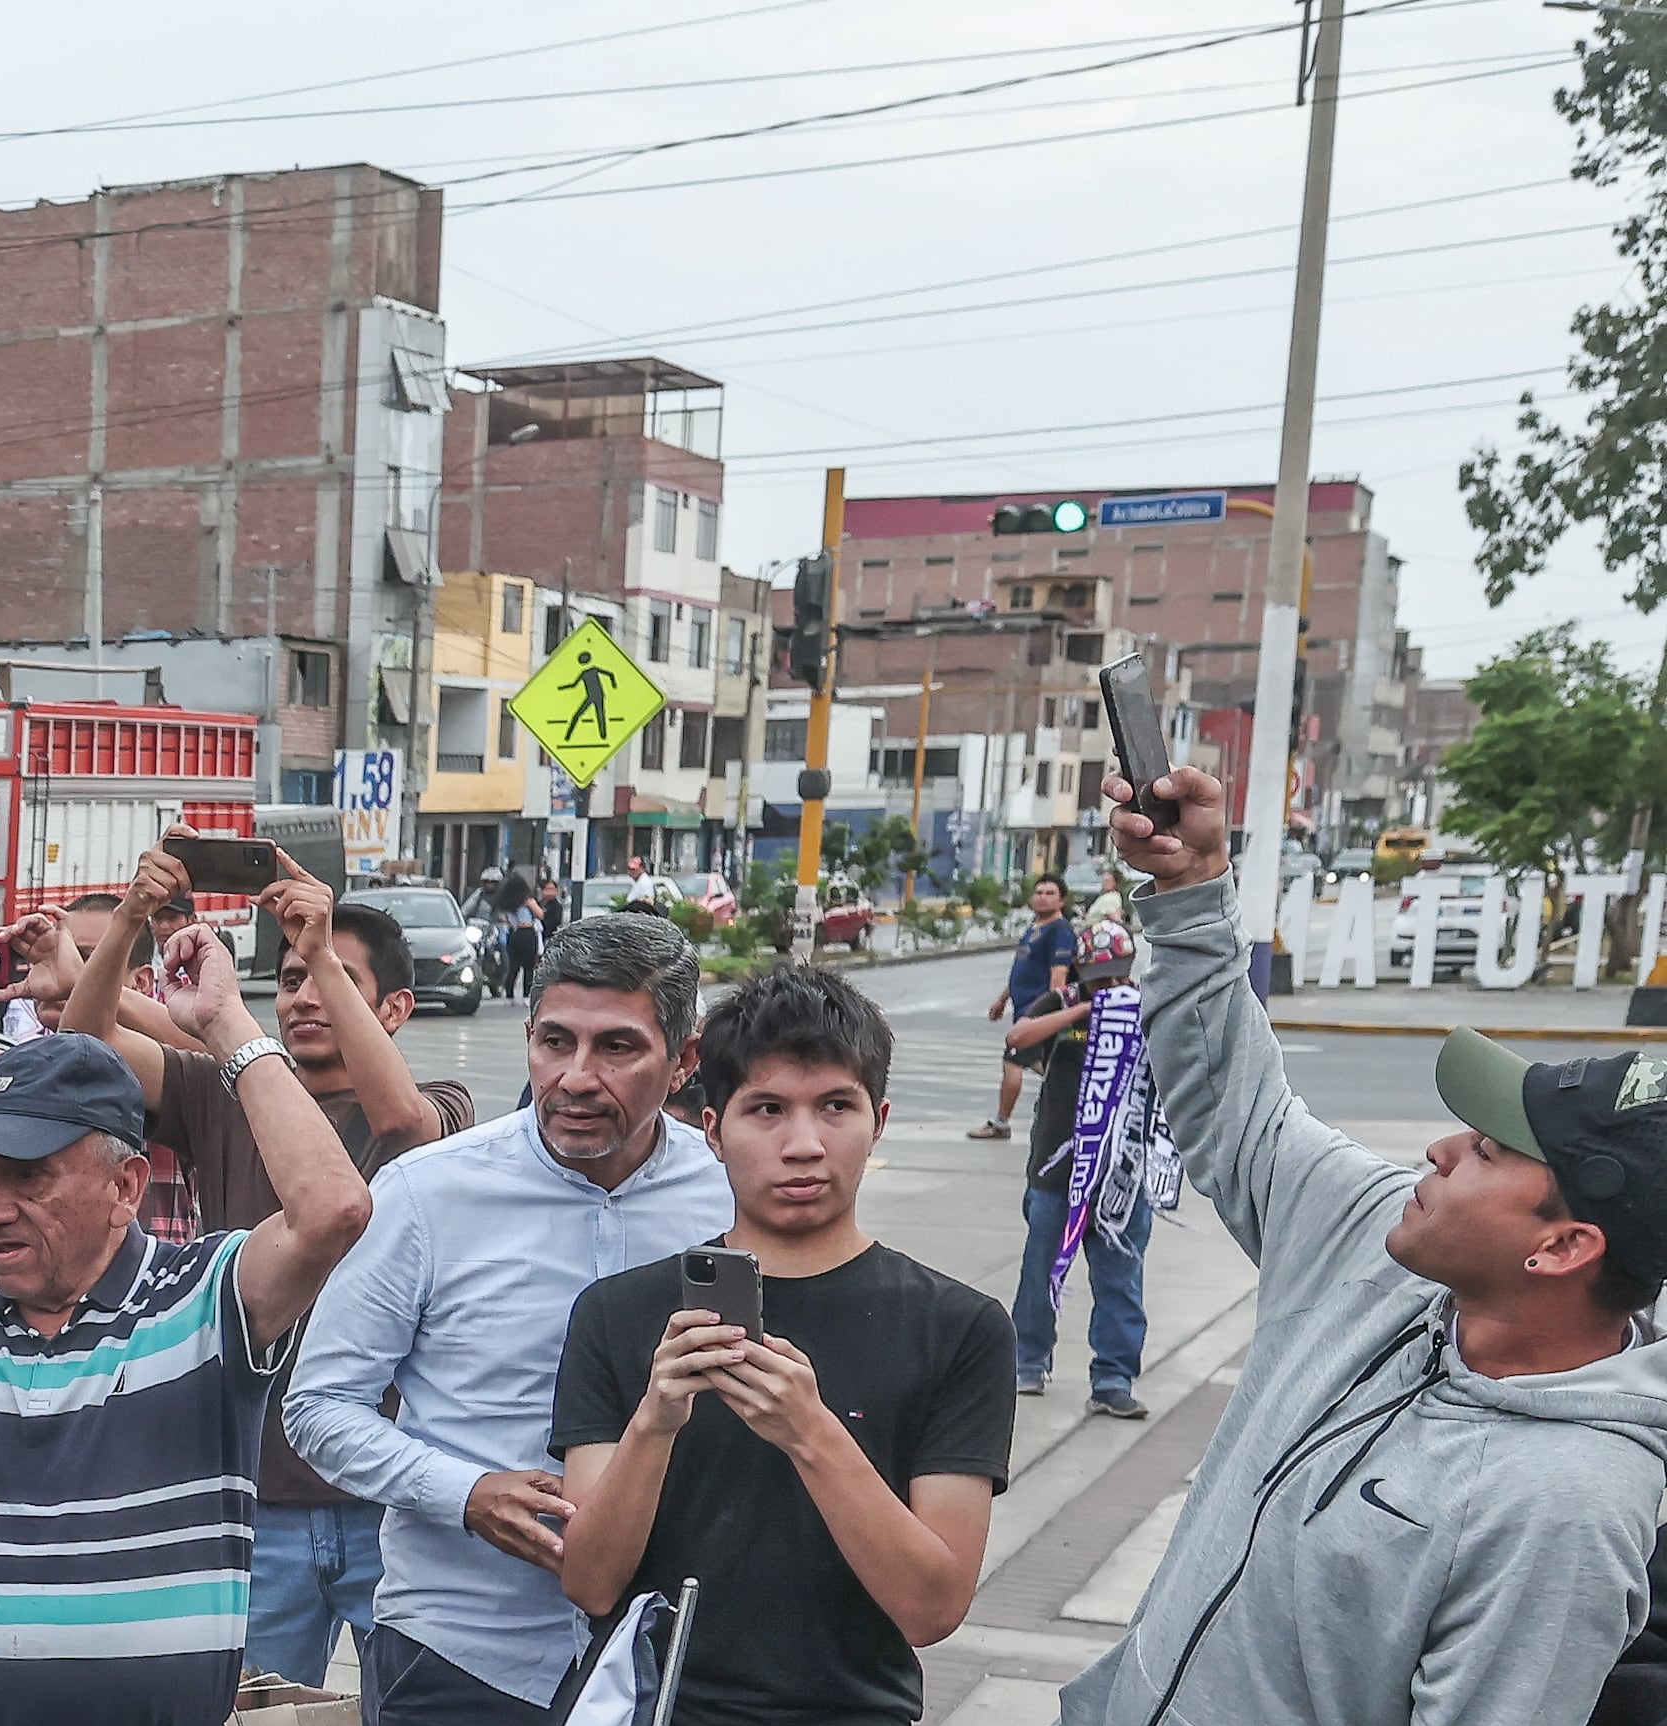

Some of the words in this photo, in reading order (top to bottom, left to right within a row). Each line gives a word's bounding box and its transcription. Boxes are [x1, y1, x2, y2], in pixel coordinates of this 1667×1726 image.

[334, 751, 393, 809] 1.58
[1082, 984, 1142, 1126] Alianza
[1070, 1134, 1101, 1207] Lima
